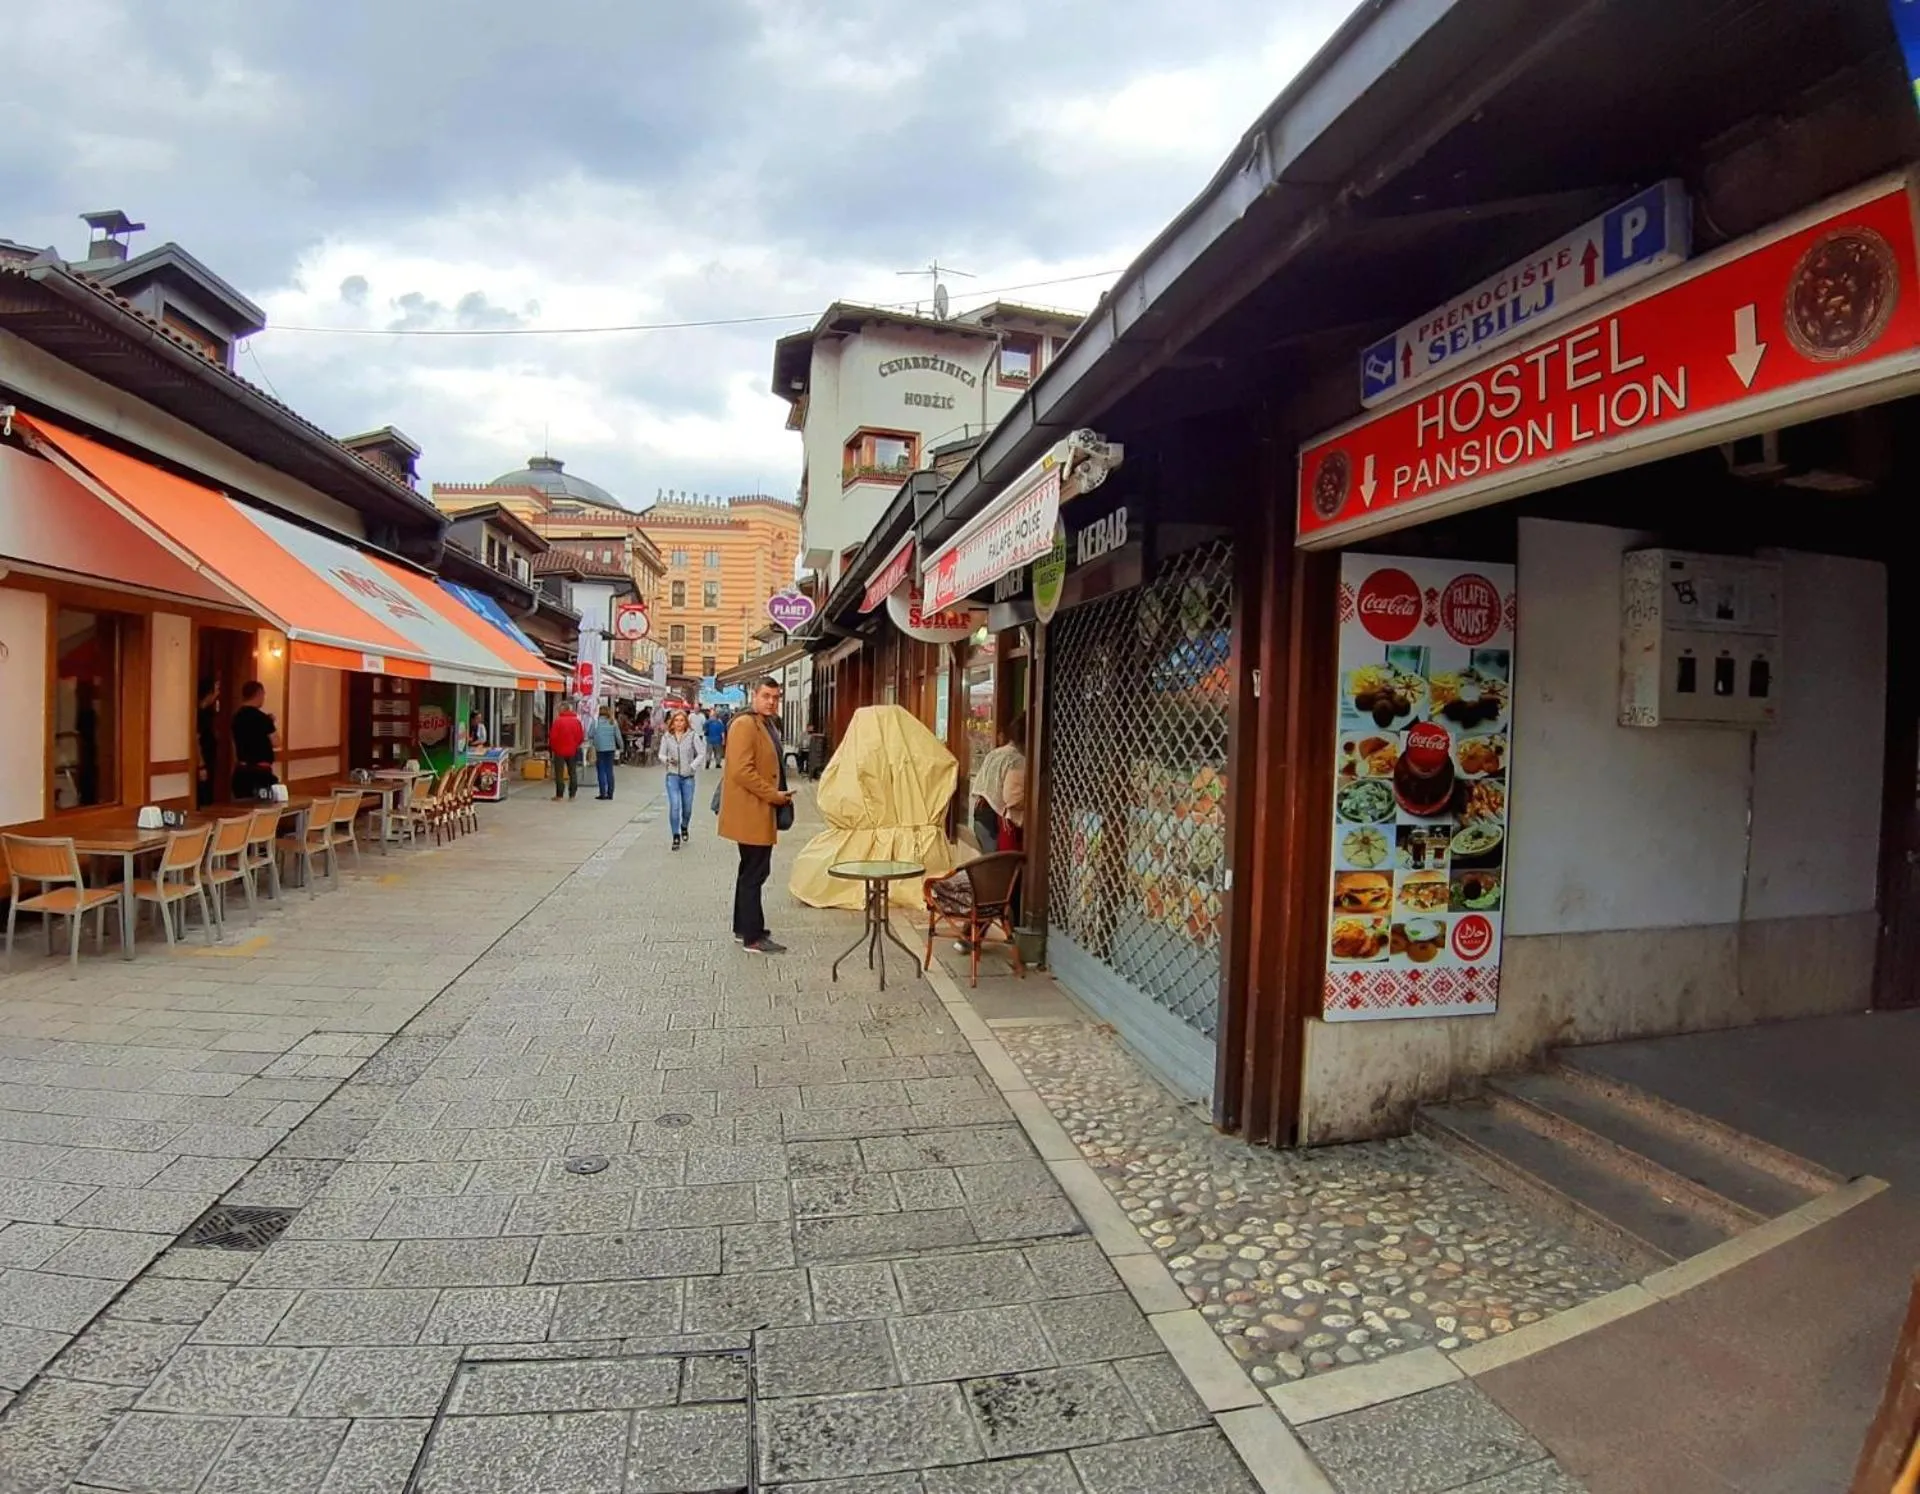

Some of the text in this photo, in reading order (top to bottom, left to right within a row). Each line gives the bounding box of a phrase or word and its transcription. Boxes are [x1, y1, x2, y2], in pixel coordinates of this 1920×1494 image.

[1620, 205, 1648, 259] P
[1428, 279, 1557, 365] SEBILJ
[1416, 318, 1645, 448] HOSTEL
[1393, 365, 1688, 499] PANSION LION
[1076, 506, 1128, 566] KEBAB
[773, 604, 807, 616] PLANET
[1453, 584, 1490, 608] FALAFEL
[1453, 608, 1489, 636] HOUSE
